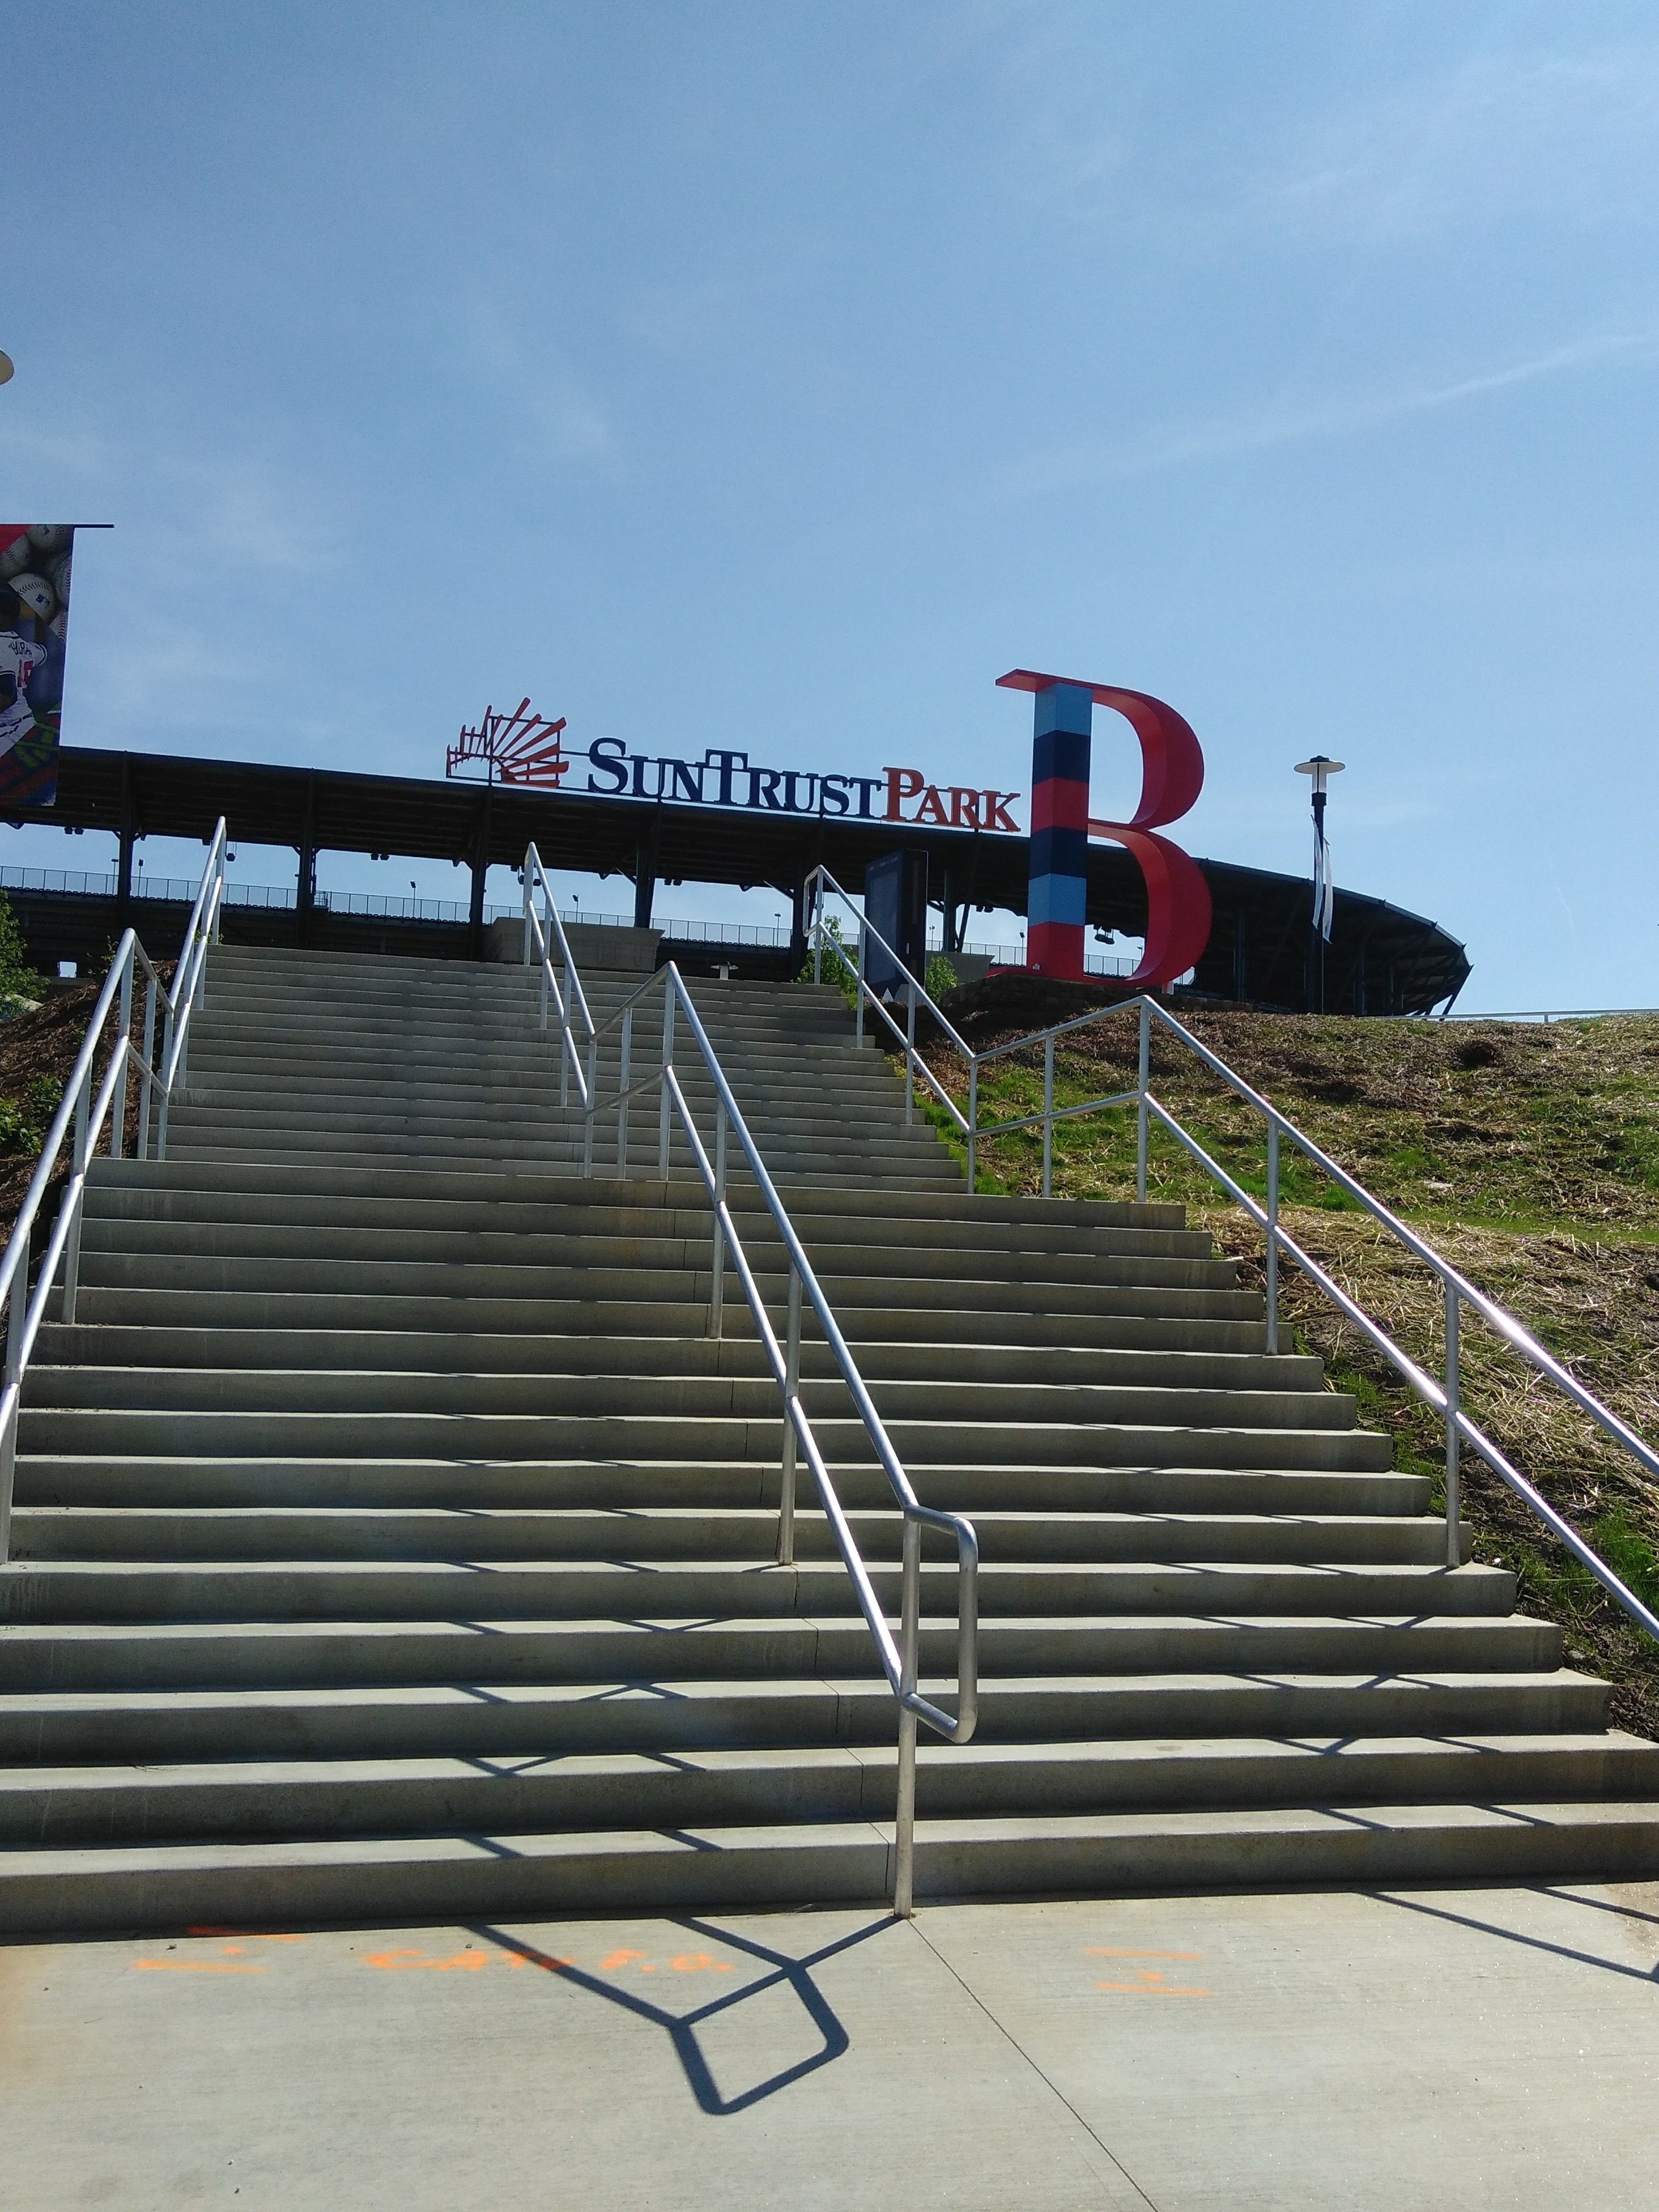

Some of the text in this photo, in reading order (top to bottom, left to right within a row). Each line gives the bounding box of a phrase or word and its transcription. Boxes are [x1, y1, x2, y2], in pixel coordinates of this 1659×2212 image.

[588, 737, 1021, 833] SUNTRUST PARK
[986, 668, 1212, 986] B
